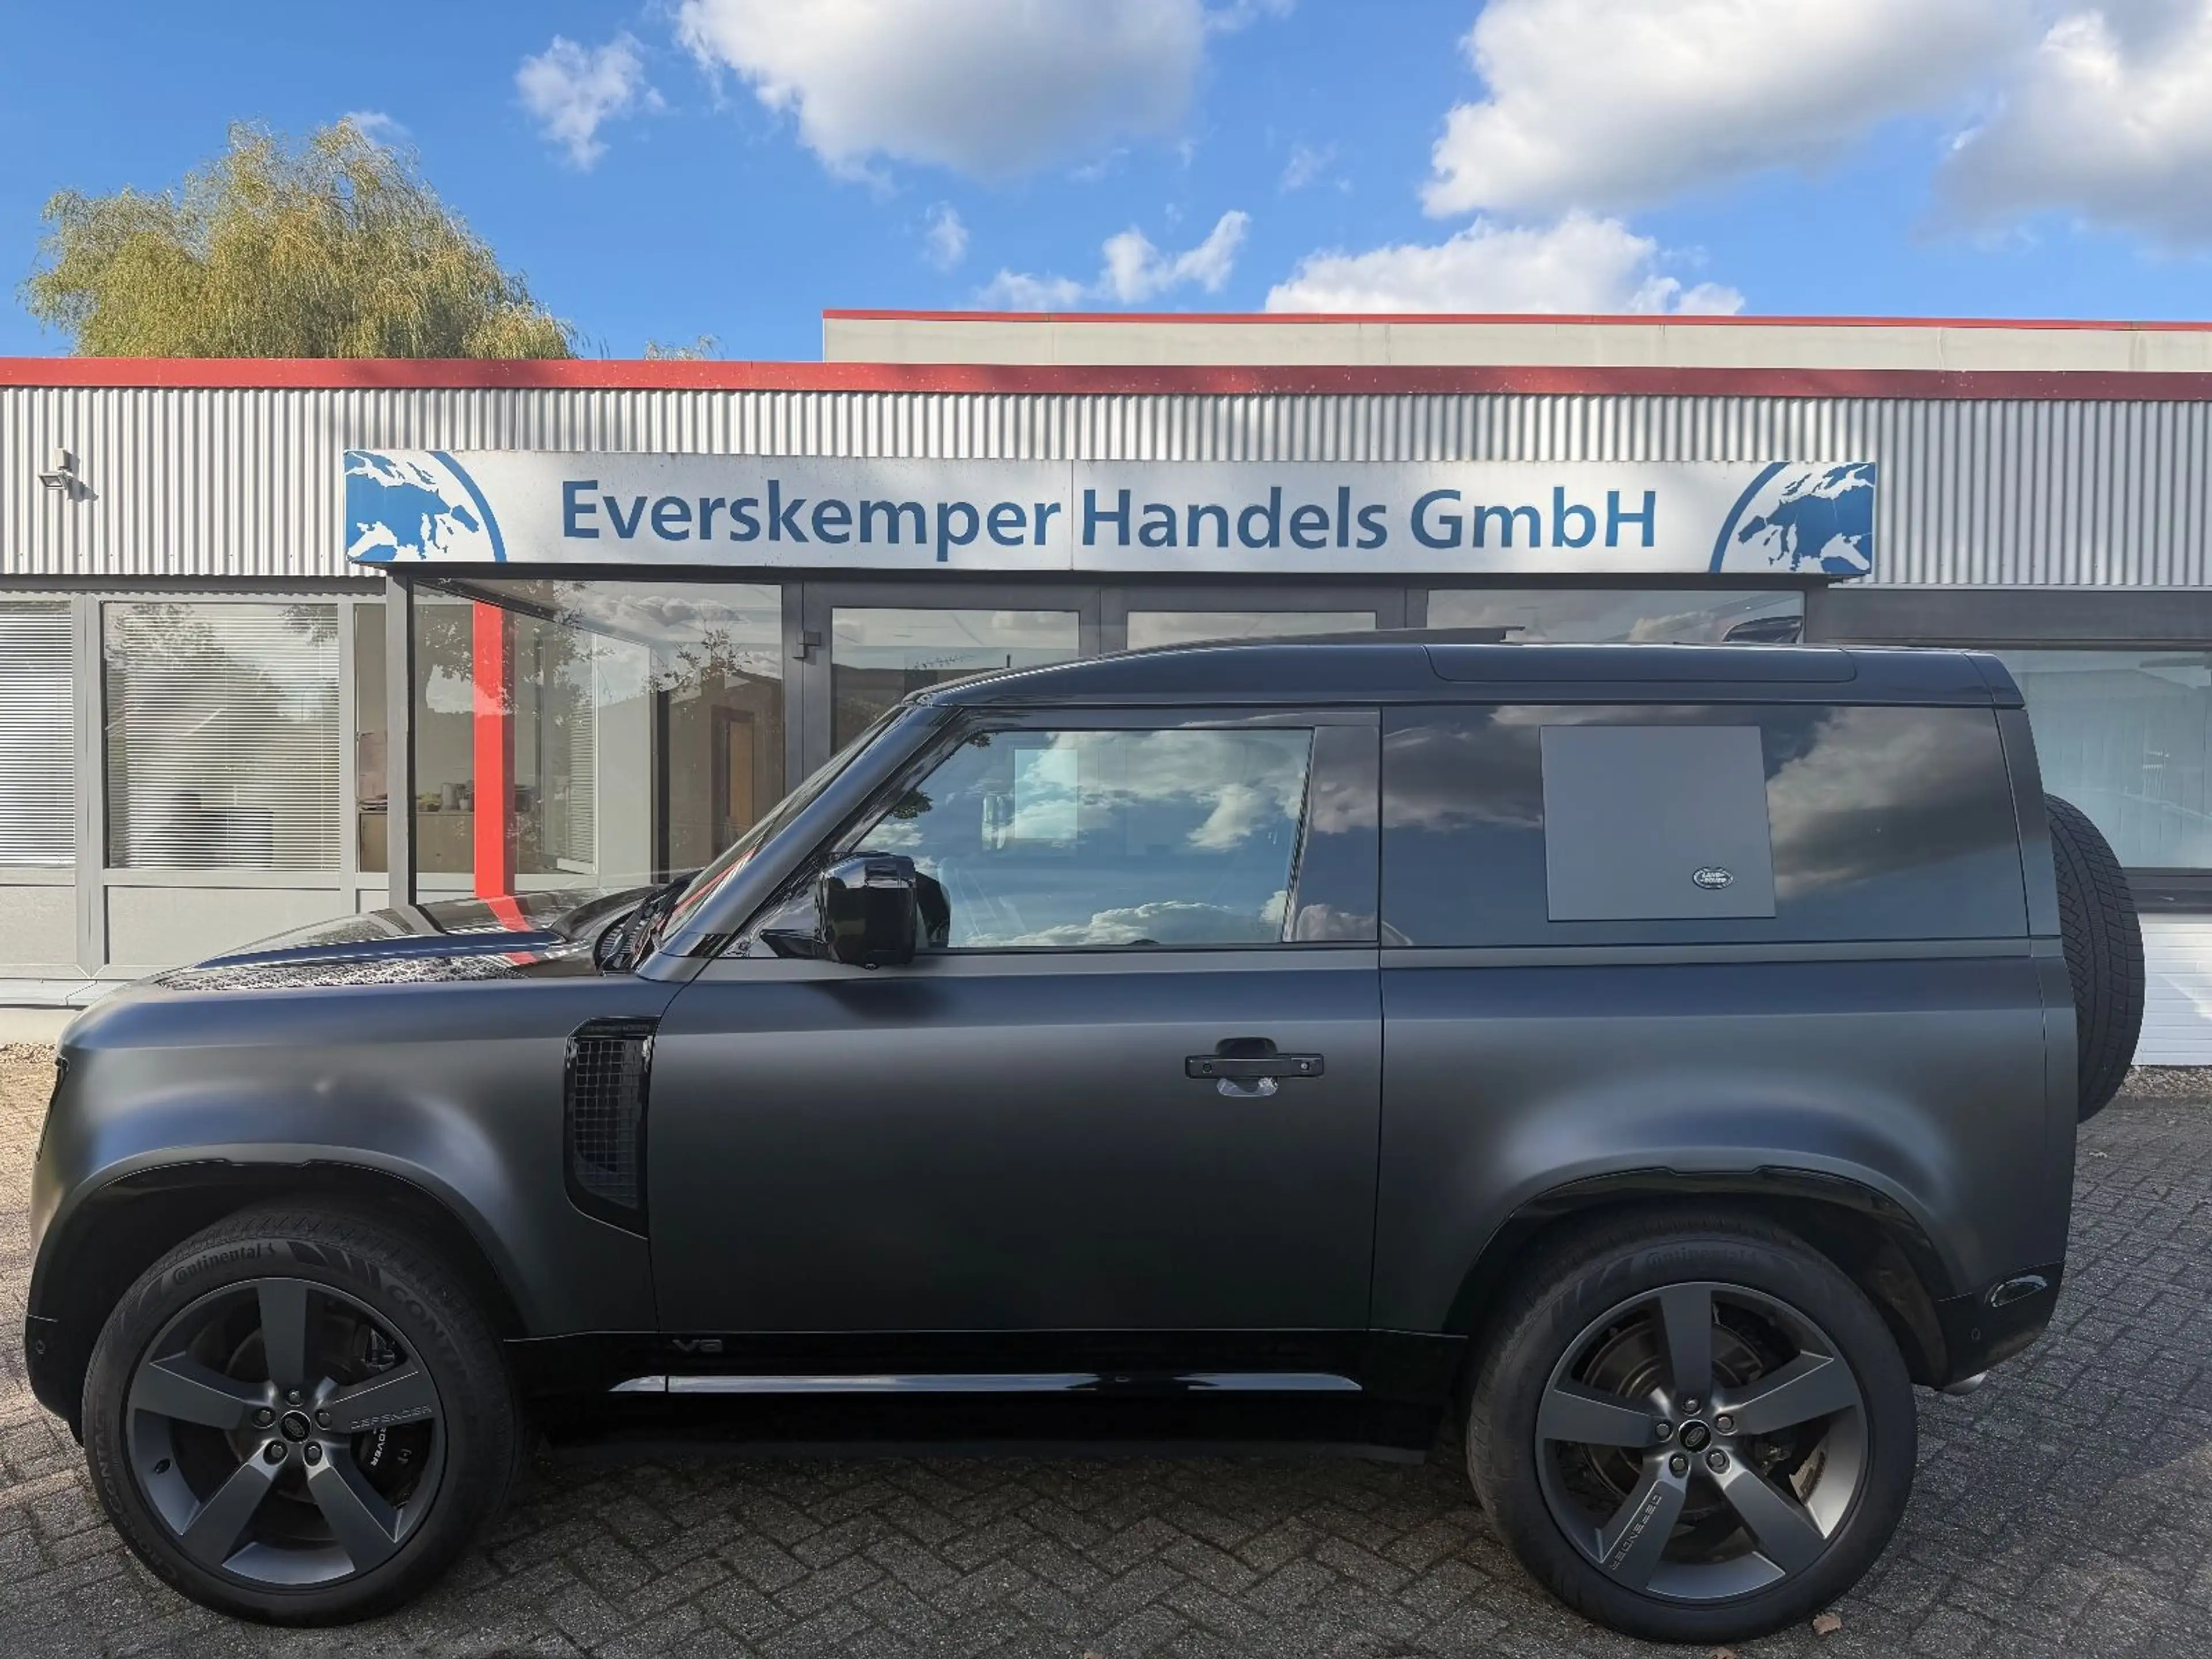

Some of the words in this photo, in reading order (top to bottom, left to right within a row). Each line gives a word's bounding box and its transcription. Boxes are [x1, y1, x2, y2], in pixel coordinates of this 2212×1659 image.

[564, 481, 1059, 562] Everskemper
[1084, 487, 1388, 550] Handels
[1411, 487, 1656, 550] GmbH
[173, 1243, 261, 1285] Continental
